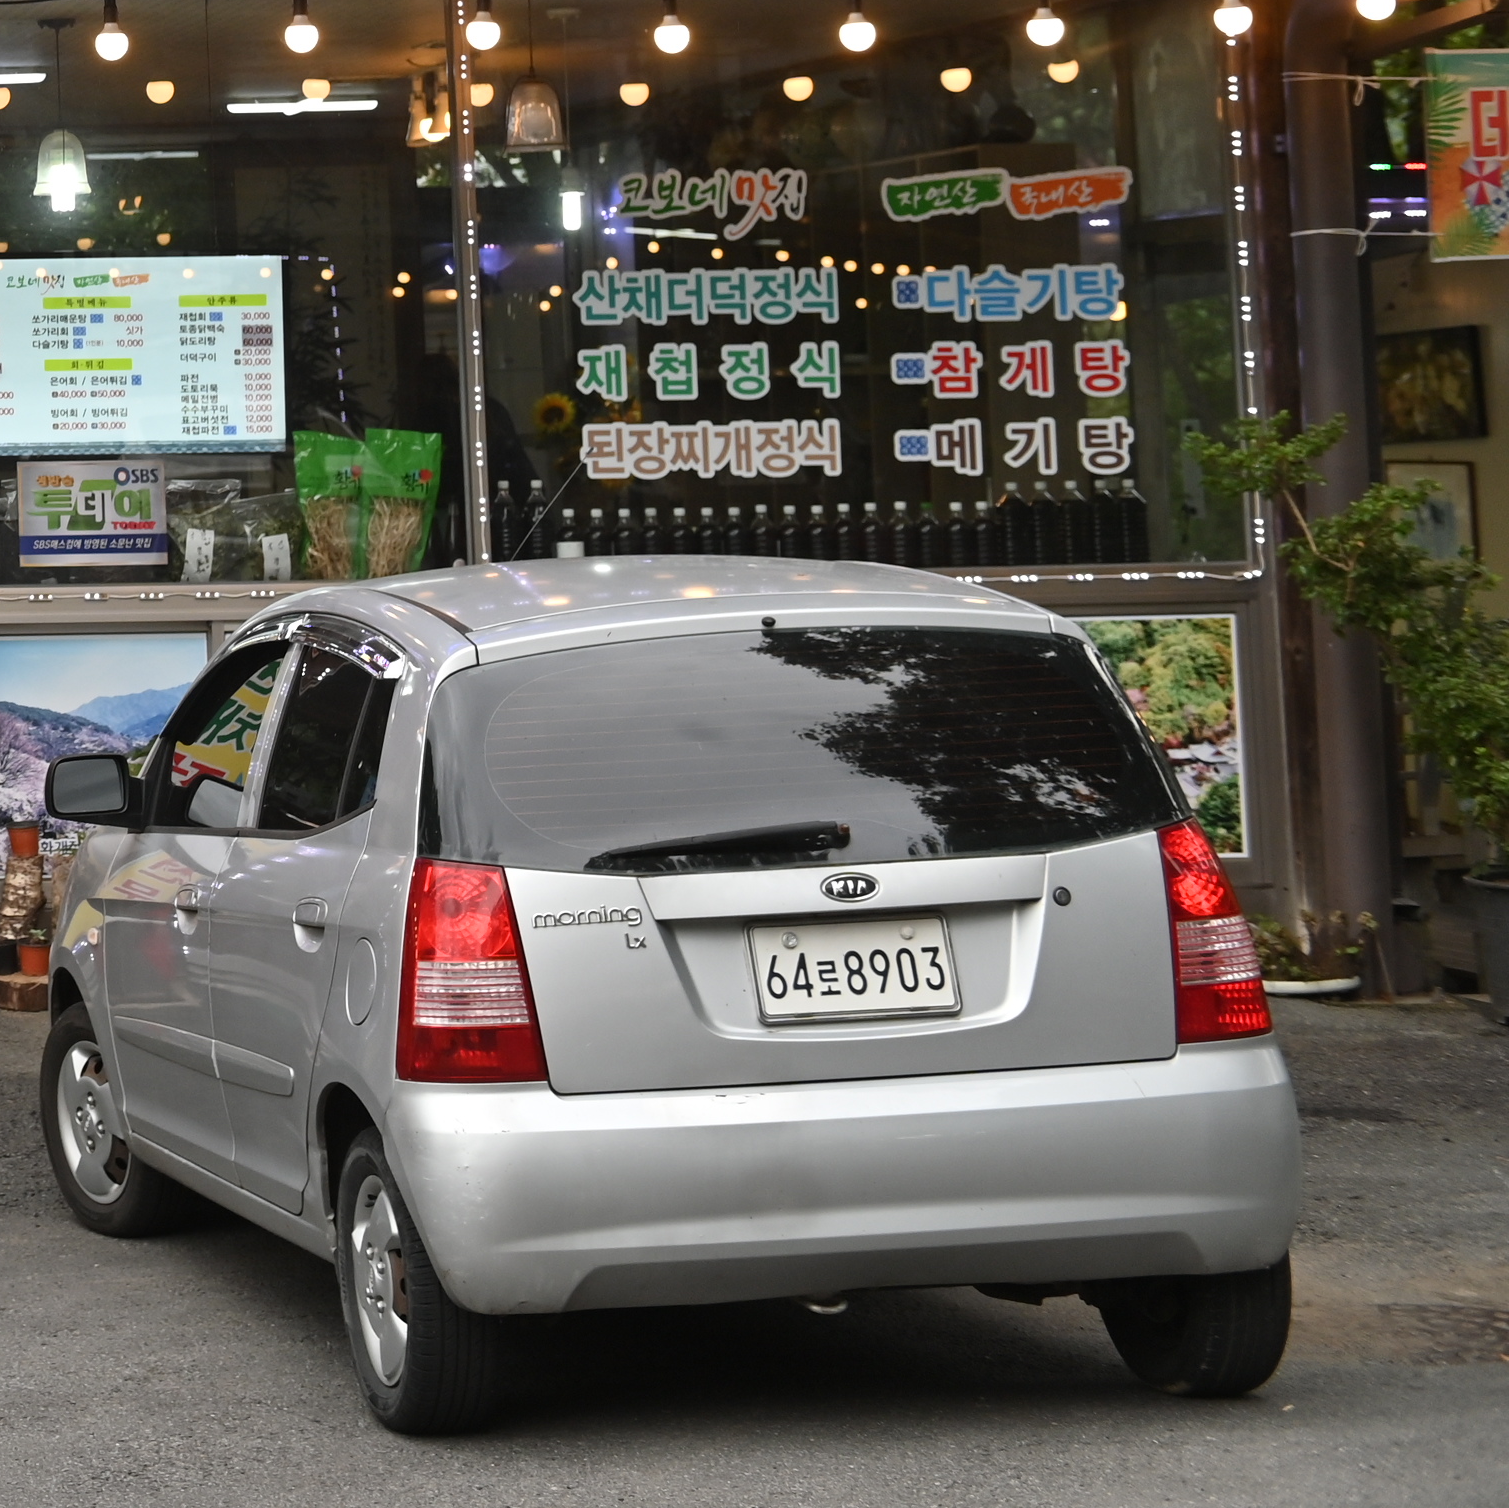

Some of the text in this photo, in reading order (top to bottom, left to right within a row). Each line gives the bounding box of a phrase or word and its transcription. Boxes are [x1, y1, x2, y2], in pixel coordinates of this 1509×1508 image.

[896, 179, 1094, 214] 자연산 국내산
[577, 271, 837, 323] 산채더덕정식
[925, 267, 1122, 319] 다슬기탕
[65, 298, 108, 308] 특별메뉴
[206, 296, 238, 306] 안주류
[32, 313, 143, 325] 쏘가리매운탕 80,000
[179, 311, 271, 322] 재첩회 30,000
[32, 326, 144, 337] 쏘가리회 싯가
[179, 324, 273, 335] 토종닭백숙 60,000
[32, 338, 143, 350] 다슬기탕 10,000
[180, 336, 273, 347] 닭도리탕 60,000
[180, 347, 271, 363] 더덕구이 20,000
[242, 357, 271, 367] 30,000
[581, 345, 838, 398] 재첩정식
[931, 345, 1126, 393] 참게탕
[50, 375, 128, 387] 은어회 은어튀김
[181, 372, 272, 383] 파전 10,000
[181, 383, 272, 394] 도토리묵 10,000
[181, 393, 272, 405] 메밀전병 10,000
[51, 408, 128, 419] 빙어회 빙어튀김
[181, 404, 272, 415] 수수부꾸미 10,000
[181, 414, 273, 425] 표고버섯전 12,000
[181, 424, 273, 436] 재첩파전 15,000
[585, 422, 839, 476] 된장찌개정식
[934, 421, 1131, 472] 메기탕
[36, 468, 159, 488] 생방송 SBS
[26, 479, 153, 531] 투데이
[111, 521, 157, 530] TODAY
[32, 537, 153, 550] SBS매스컴에 방영된 소문난 맛집
[830, 878, 869, 898] KIA
[531, 903, 642, 929] morning
[765, 945, 947, 1000] 64로8903
